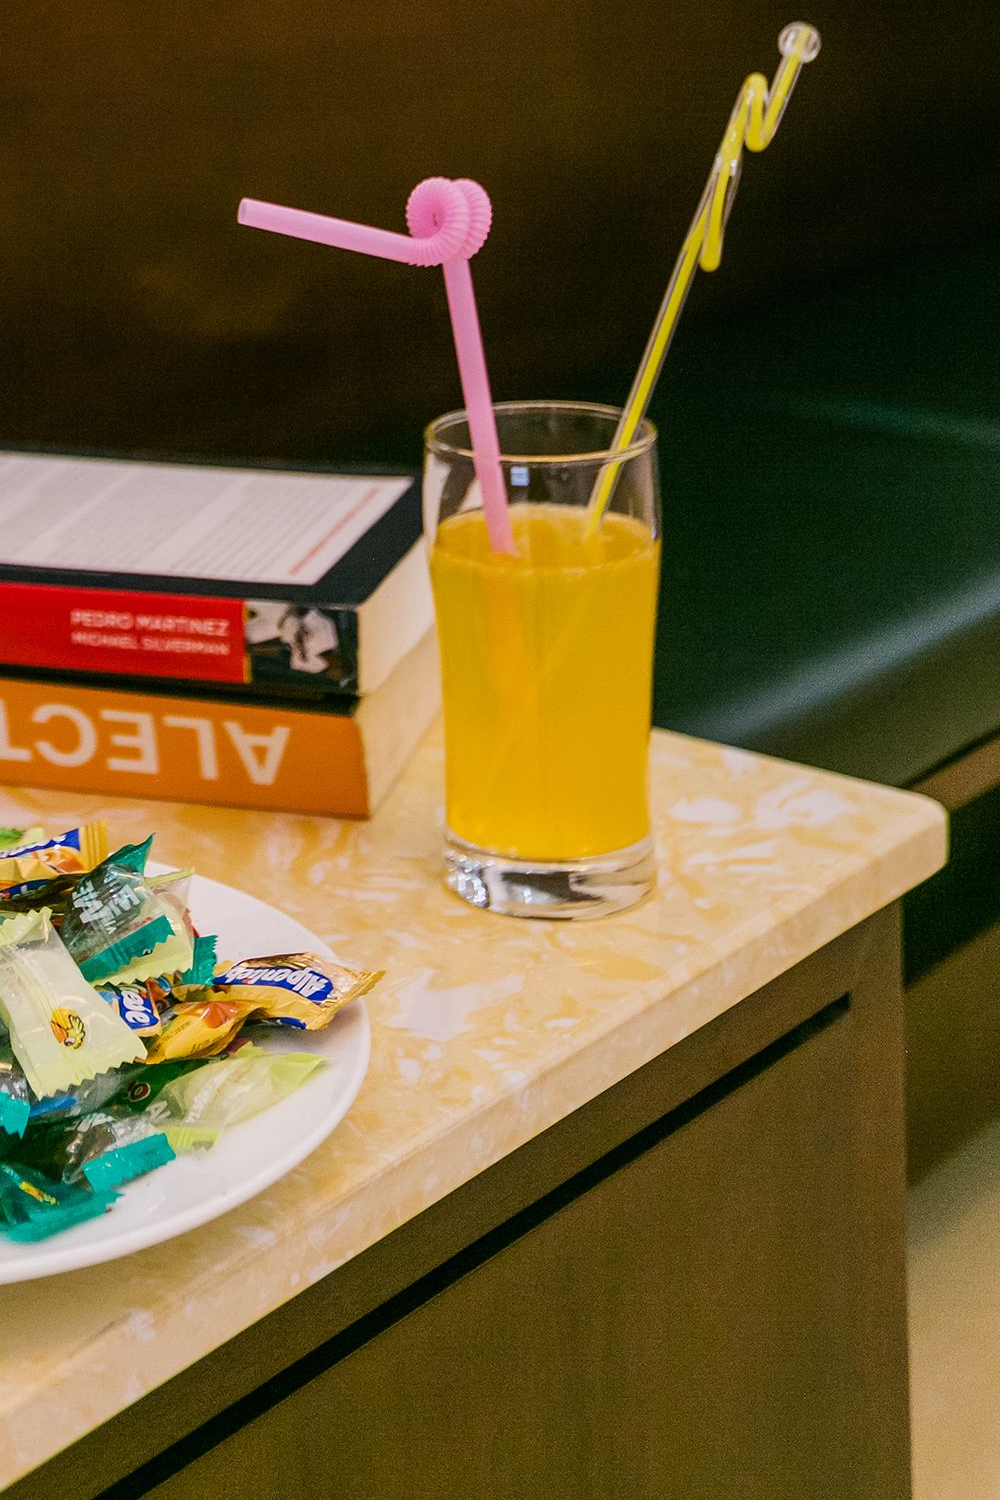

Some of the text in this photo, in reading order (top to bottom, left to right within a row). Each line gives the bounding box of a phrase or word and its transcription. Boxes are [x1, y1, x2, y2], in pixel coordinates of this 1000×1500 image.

[70, 608, 230, 638] PEDRO MARTINEZ
[220, 964, 328, 1000] Alpenlieb
